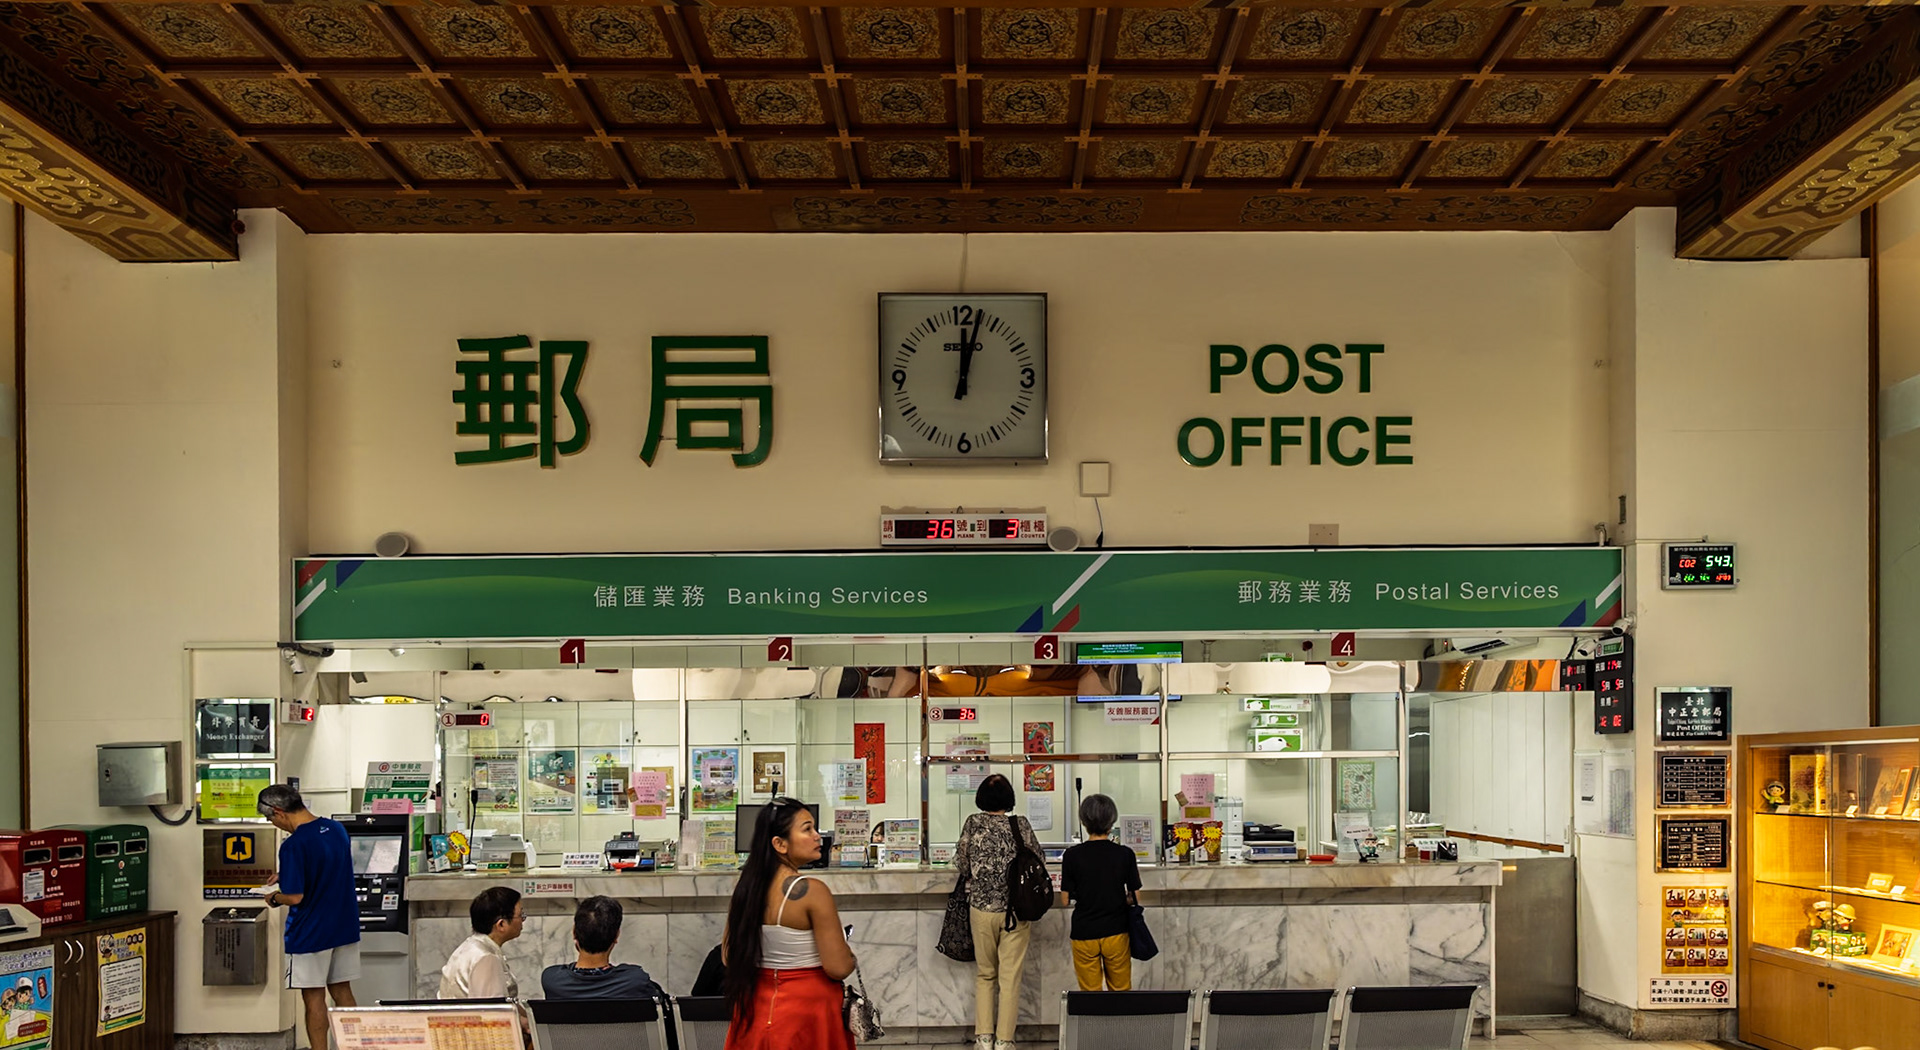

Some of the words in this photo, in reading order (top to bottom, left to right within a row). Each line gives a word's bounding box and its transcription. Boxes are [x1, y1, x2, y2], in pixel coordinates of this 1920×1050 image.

[953, 305, 973, 326] 12
[943, 343, 983, 352] SEO
[1209, 343, 1385, 395] POST
[891, 369, 907, 391] 9
[1020, 368, 1036, 389] 3
[453, 334, 774, 469] 郵局
[957, 432, 972, 454] 6
[1177, 416, 1414, 467] OFFICE
[927, 520, 953, 539] 36
[977, 520, 987, 532] 到
[1006, 519, 1019, 539] 3
[593, 585, 706, 609] 儲匯業務
[728, 587, 821, 609] Banking
[831, 587, 929, 604] Services
[1238, 580, 1352, 604] 郵務業務
[1375, 582, 1449, 601] Postal
[1459, 580, 1560, 600] Services
[571, 646, 579, 664] 1
[778, 645, 790, 662] 2
[1043, 643, 1055, 660] 3
[1340, 639, 1354, 656] 4
[306, 708, 314, 721] 2
[479, 713, 490, 726] 0
[959, 708, 976, 720] 36
[206, 733, 228, 742] Money
[229, 733, 265, 742] Exchanger
[1688, 889, 1696, 900] 2
[1709, 889, 1717, 900] 3
[1667, 929, 1675, 939] 4
[1688, 929, 1695, 939] 5
[1709, 929, 1717, 939] 6
[1667, 949, 1674, 960] 7
[1687, 949, 1695, 959] 8
[1709, 949, 1717, 960] 9
